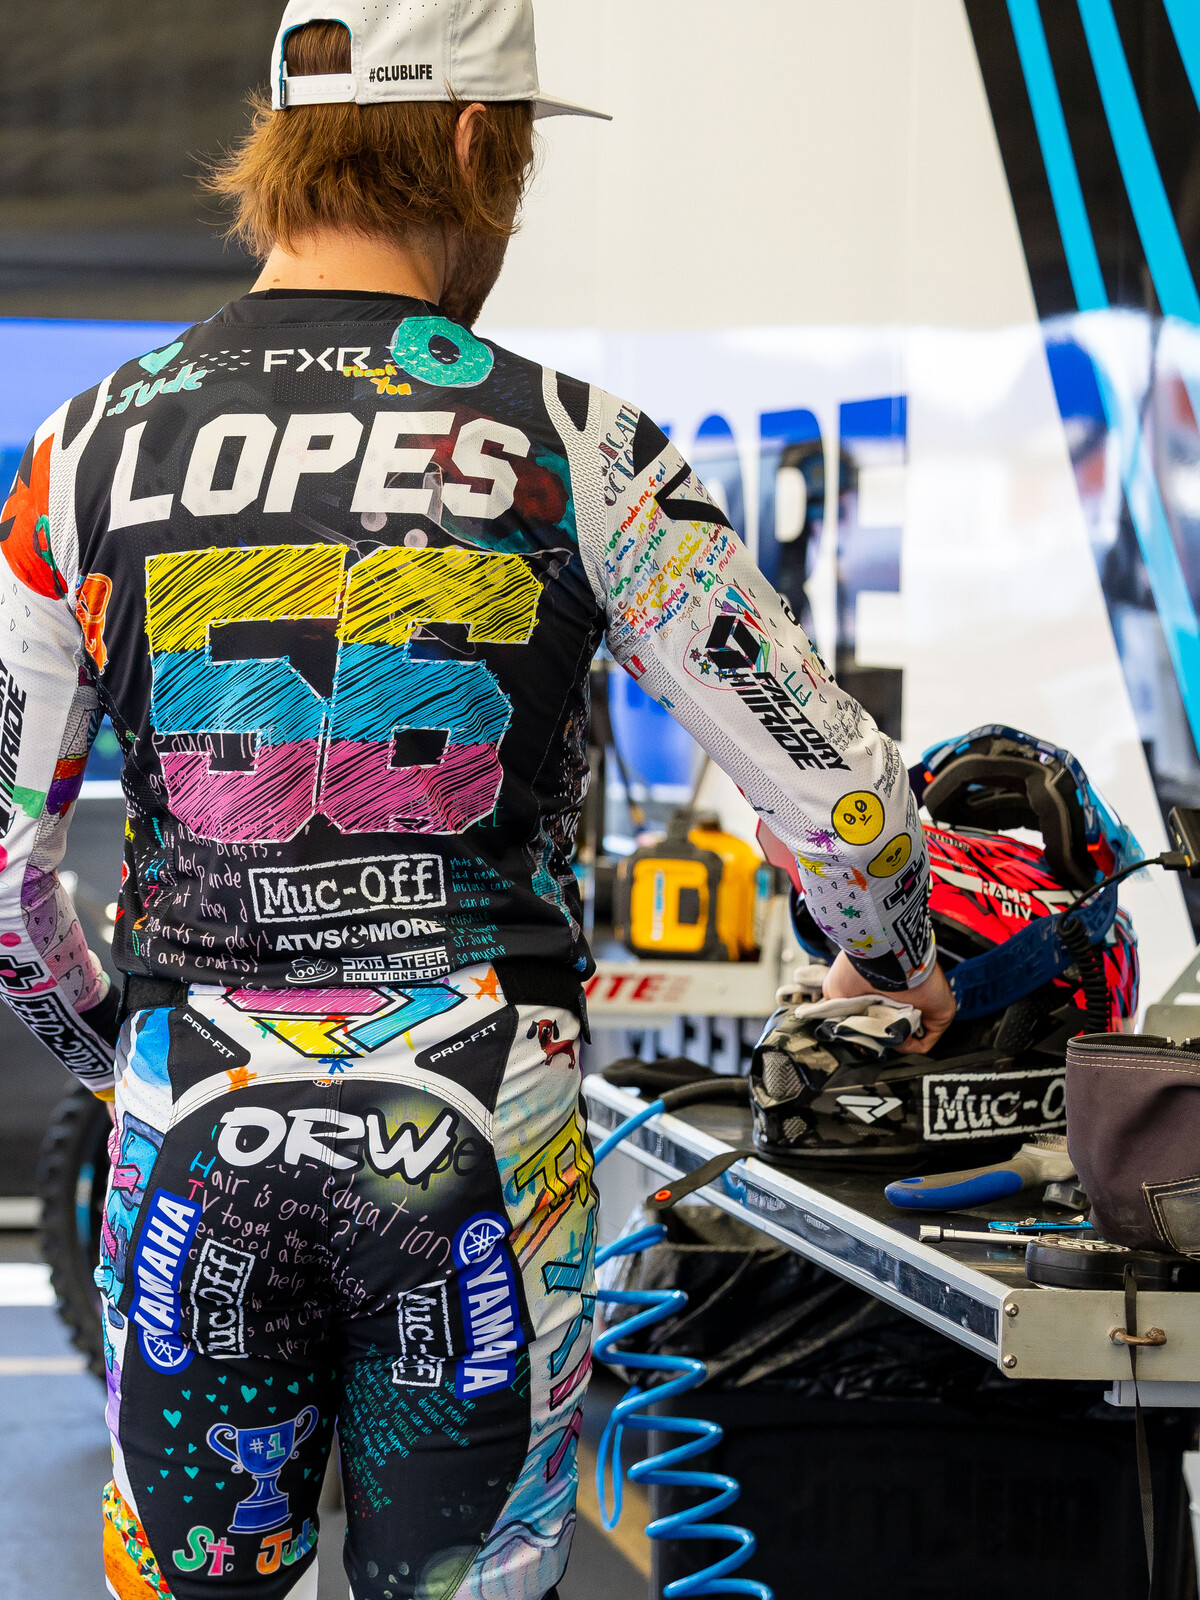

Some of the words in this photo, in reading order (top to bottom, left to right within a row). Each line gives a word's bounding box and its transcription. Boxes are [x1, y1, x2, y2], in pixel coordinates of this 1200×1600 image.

[368, 64, 433, 83] #CLUBLIFE
[263, 346, 371, 372] FXR
[370, 377, 412, 395] You
[107, 411, 532, 531] LOPES
[616, 537, 636, 560] was
[144, 542, 545, 844] 56
[752, 672, 852, 771] FACTORY
[261, 858, 437, 915] Muc-Off
[1001, 901, 1032, 921] DIV
[275, 919, 447, 952] ATVS&MORE
[341, 955, 390, 971] SKID
[393, 946, 448, 968] STEER
[343, 966, 450, 982] SOLUTIONS.COM
[182, 1012, 236, 1060] PRO-FIT
[430, 1020, 500, 1063] PRO-FIT
[189, 1151, 249, 1195] Hair
[254, 1184, 273, 1208] is
[134, 1194, 197, 1338] YAMAHA
[417, 1397, 445, 1425] doctors
[391, 1411, 420, 1446] MIRACLE
[248, 1436, 286, 1461] #1
[172, 1525, 235, 1576] St.
